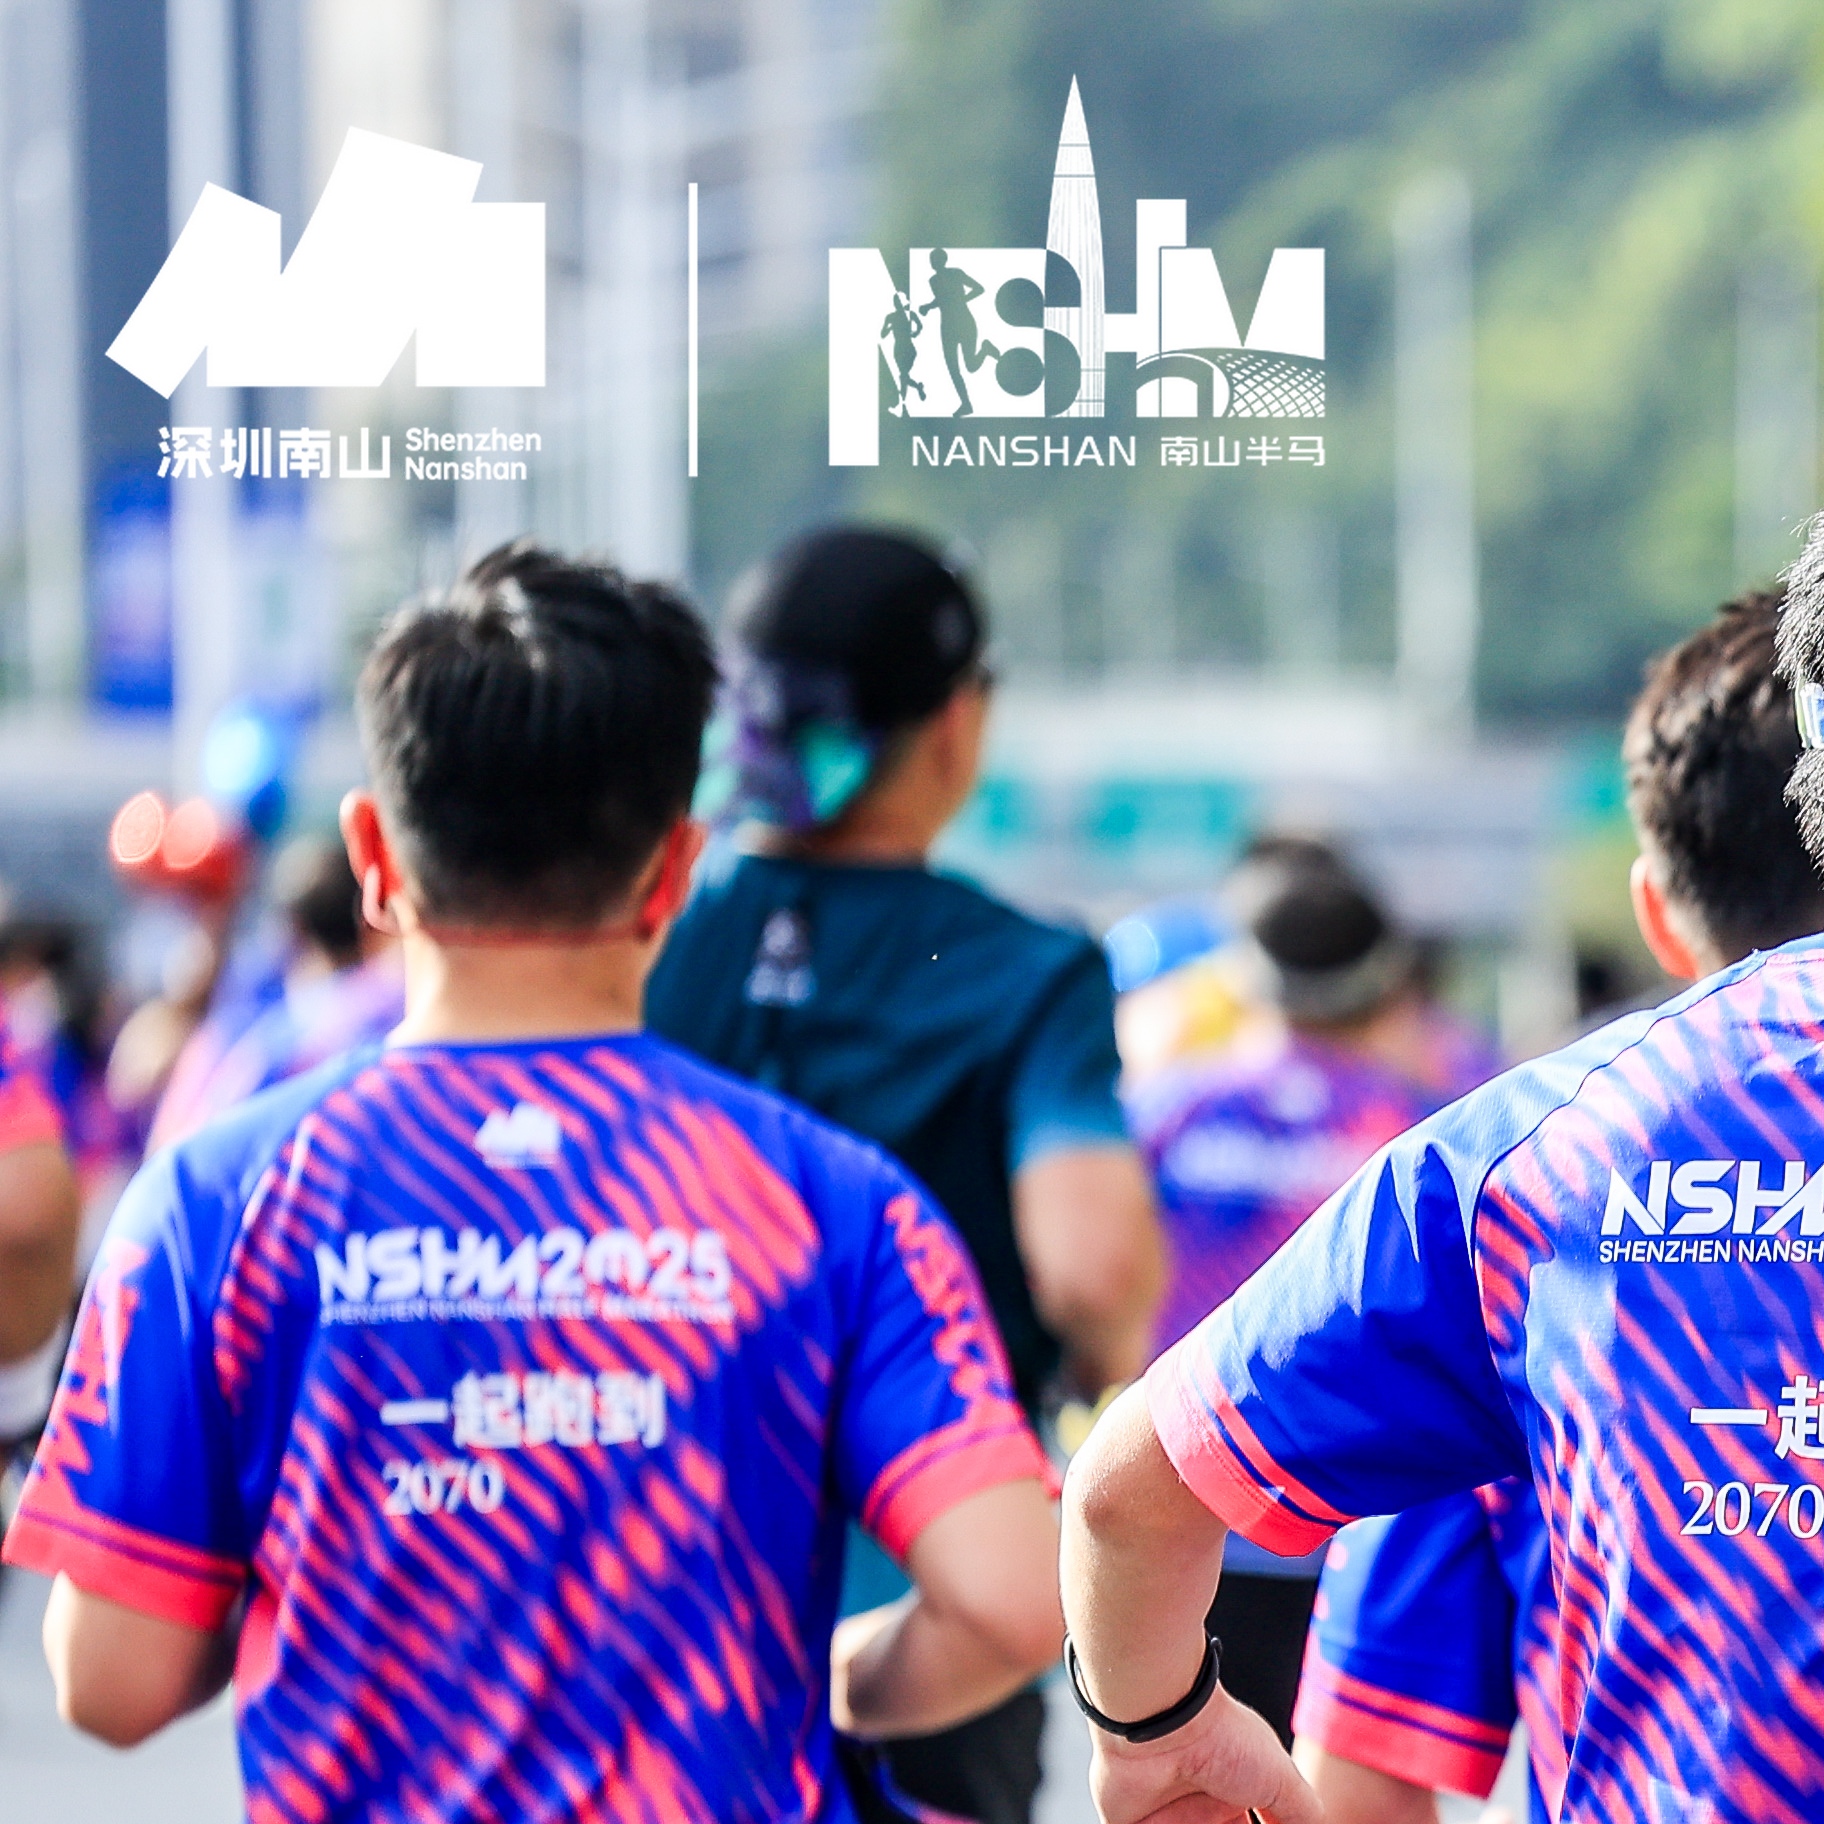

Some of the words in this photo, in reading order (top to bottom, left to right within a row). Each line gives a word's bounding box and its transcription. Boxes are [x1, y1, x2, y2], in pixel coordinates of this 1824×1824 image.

[1600, 1240, 1731, 1265] SHENZHEN
[381, 1372, 667, 1448] 一起跑到
[382, 1459, 502, 1516] 2070
